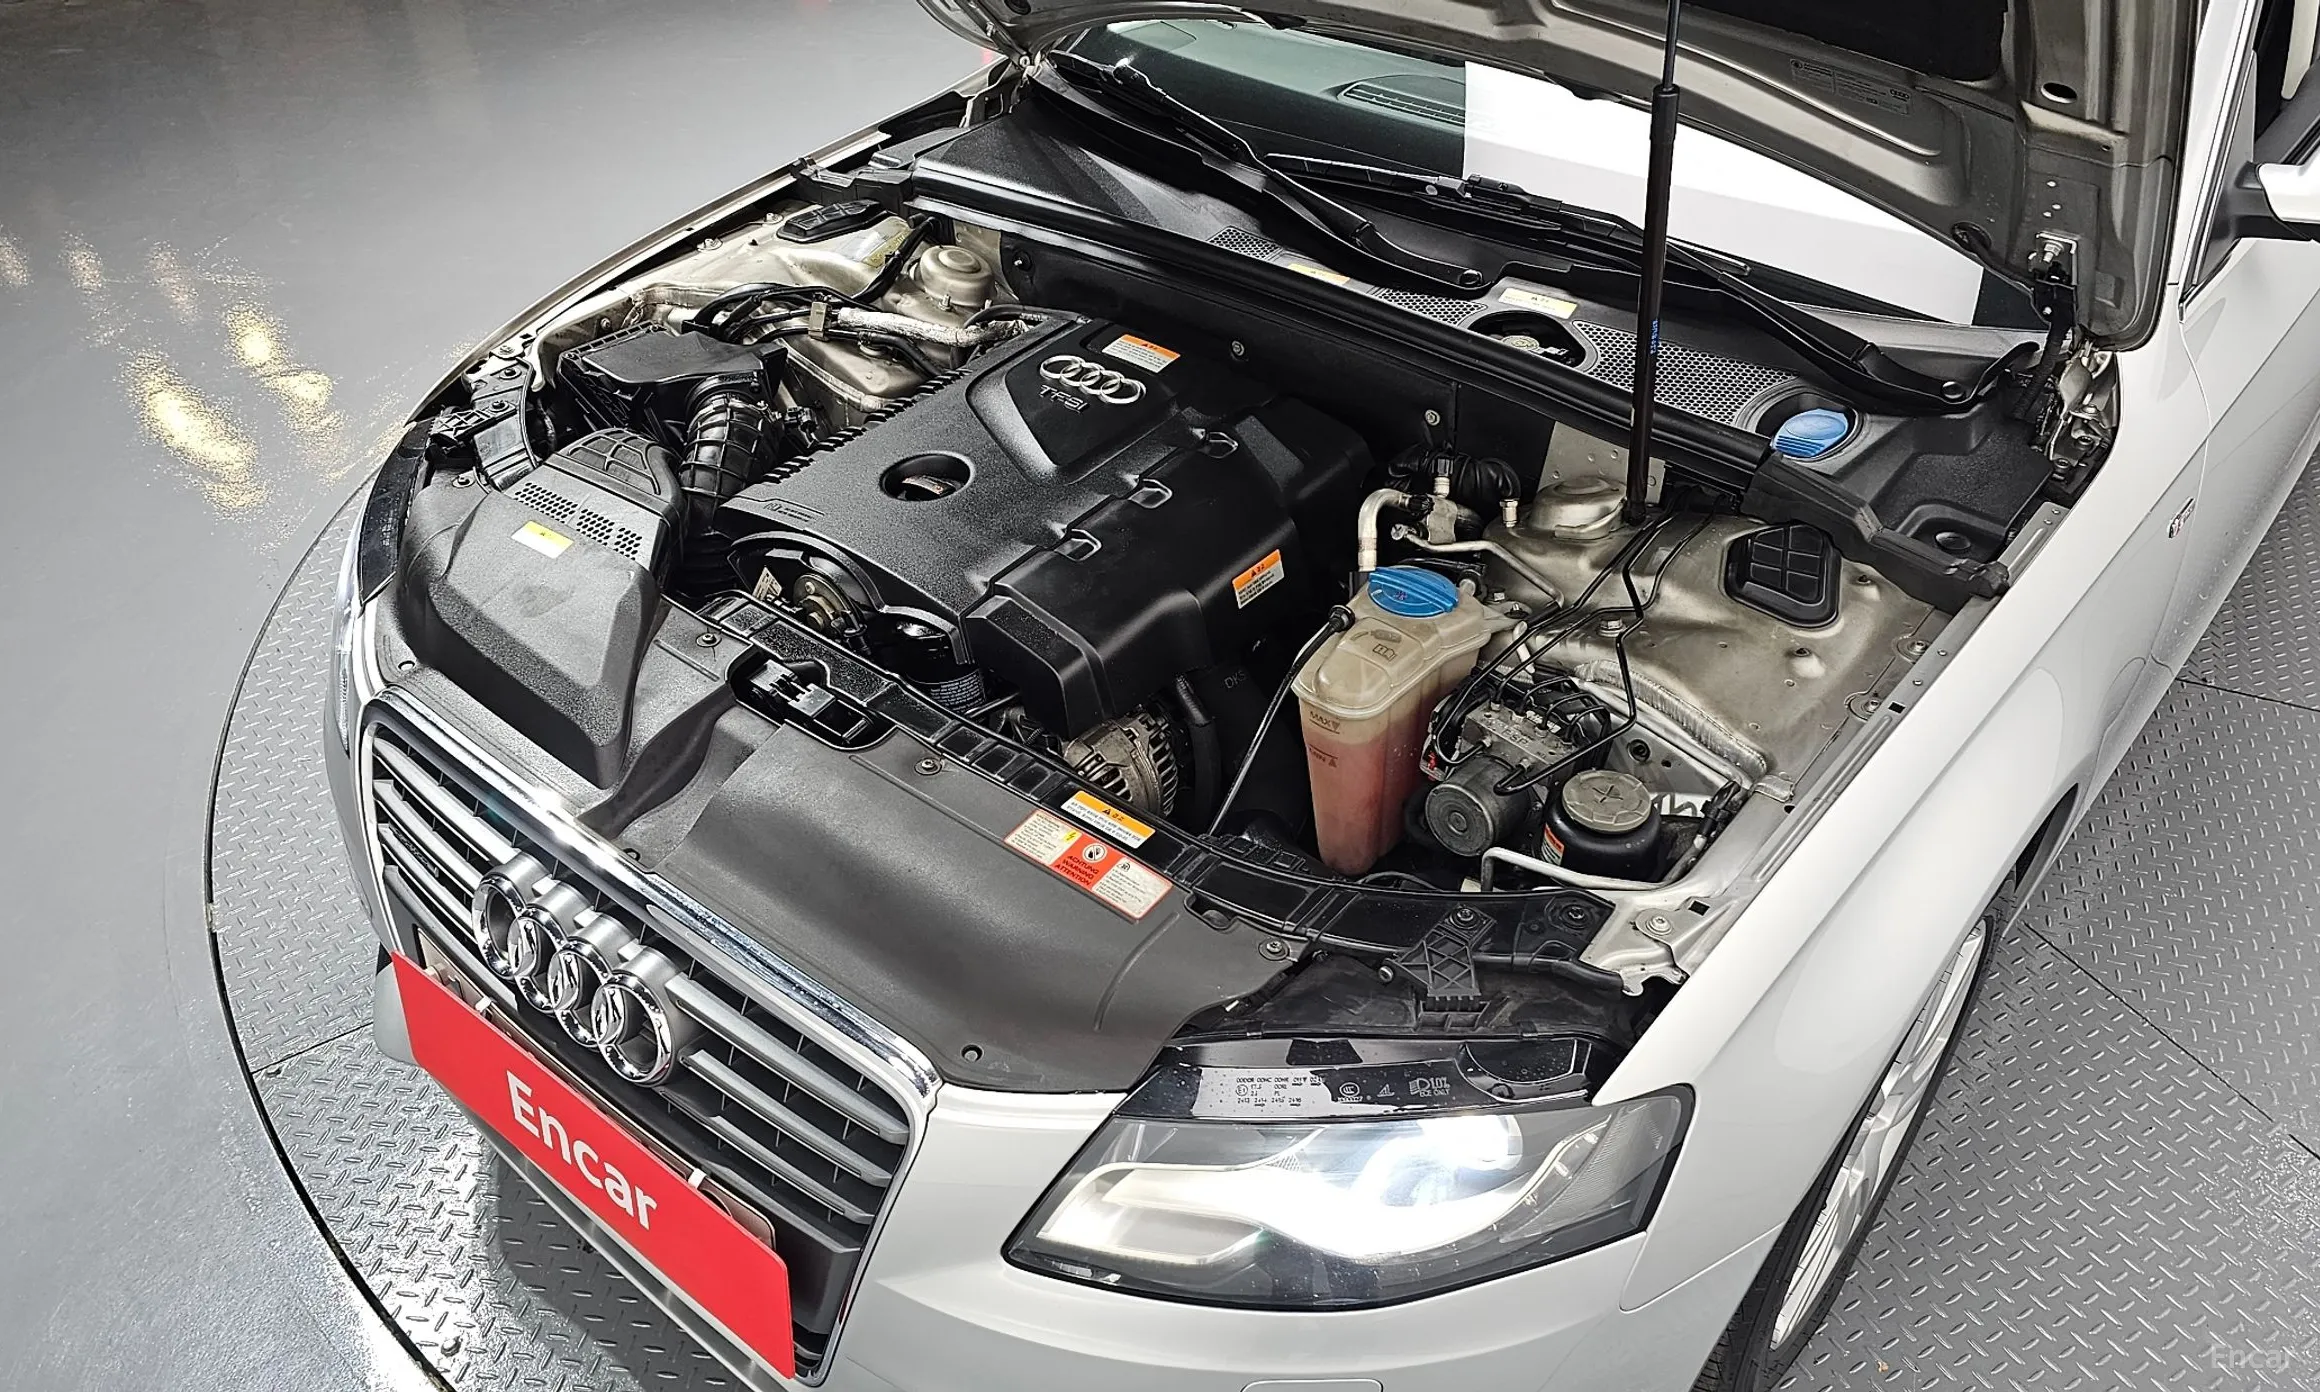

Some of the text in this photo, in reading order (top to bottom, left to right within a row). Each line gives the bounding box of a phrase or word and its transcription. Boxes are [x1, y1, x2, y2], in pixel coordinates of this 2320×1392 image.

[1038, 385, 1088, 412] TFSI
[1054, 864, 1092, 886] ATTENTION
[1062, 859, 1095, 880] WARNING
[1067, 855, 1100, 875] ACHTUNG
[506, 1069, 658, 1231] Encar
